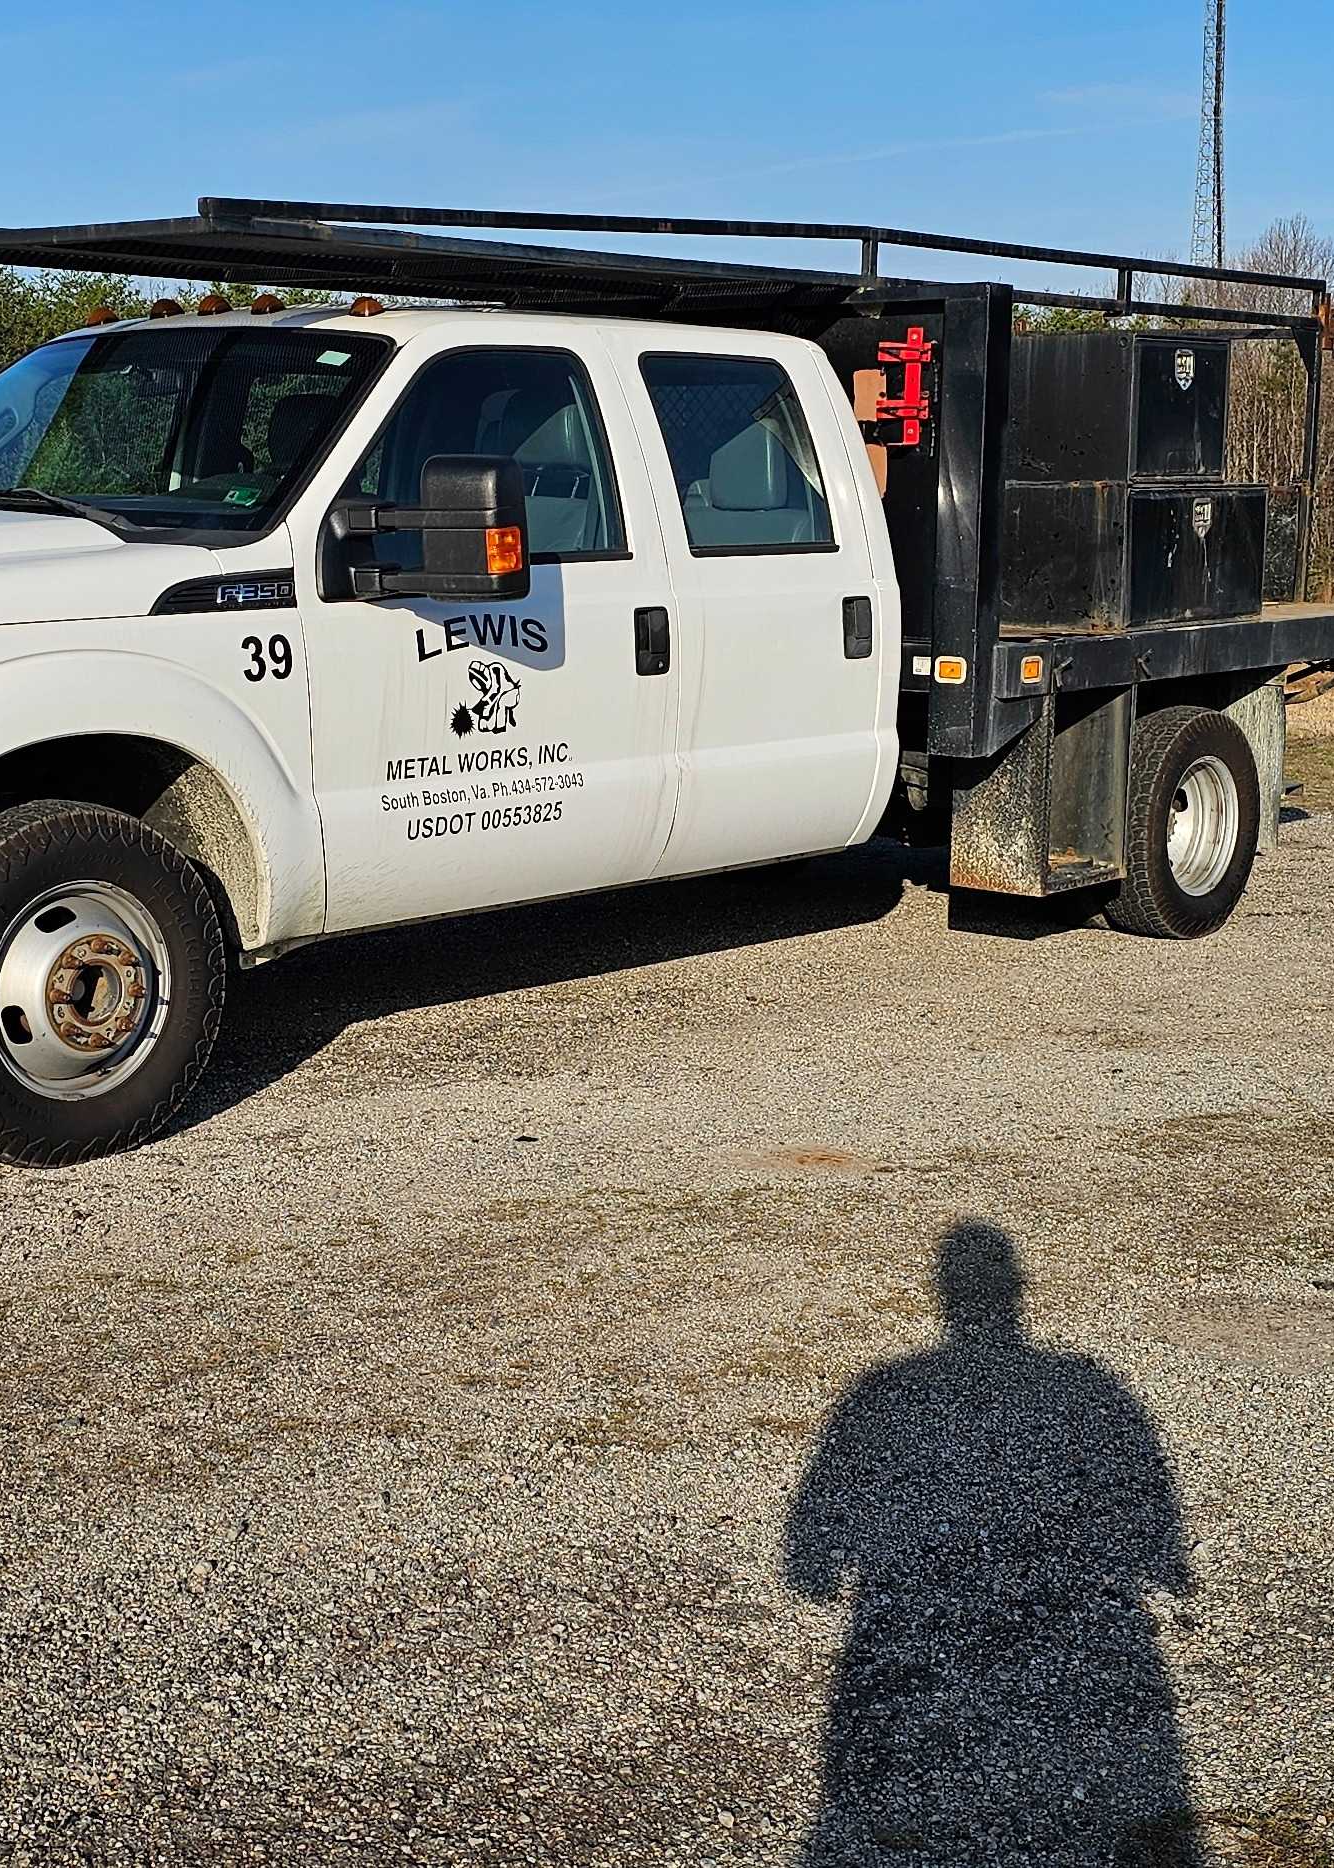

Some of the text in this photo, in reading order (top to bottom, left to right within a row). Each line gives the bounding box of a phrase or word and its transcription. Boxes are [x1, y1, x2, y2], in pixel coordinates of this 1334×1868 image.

[241, 633, 293, 682] 39
[415, 613, 548, 662] LEWIS
[386, 755, 452, 781] METAL
[458, 747, 534, 773] WORKS,
[381, 793, 419, 812] South
[423, 788, 471, 806] Boston,
[471, 784, 490, 801] Va.
[407, 800, 563, 840] USDOT 00553825
